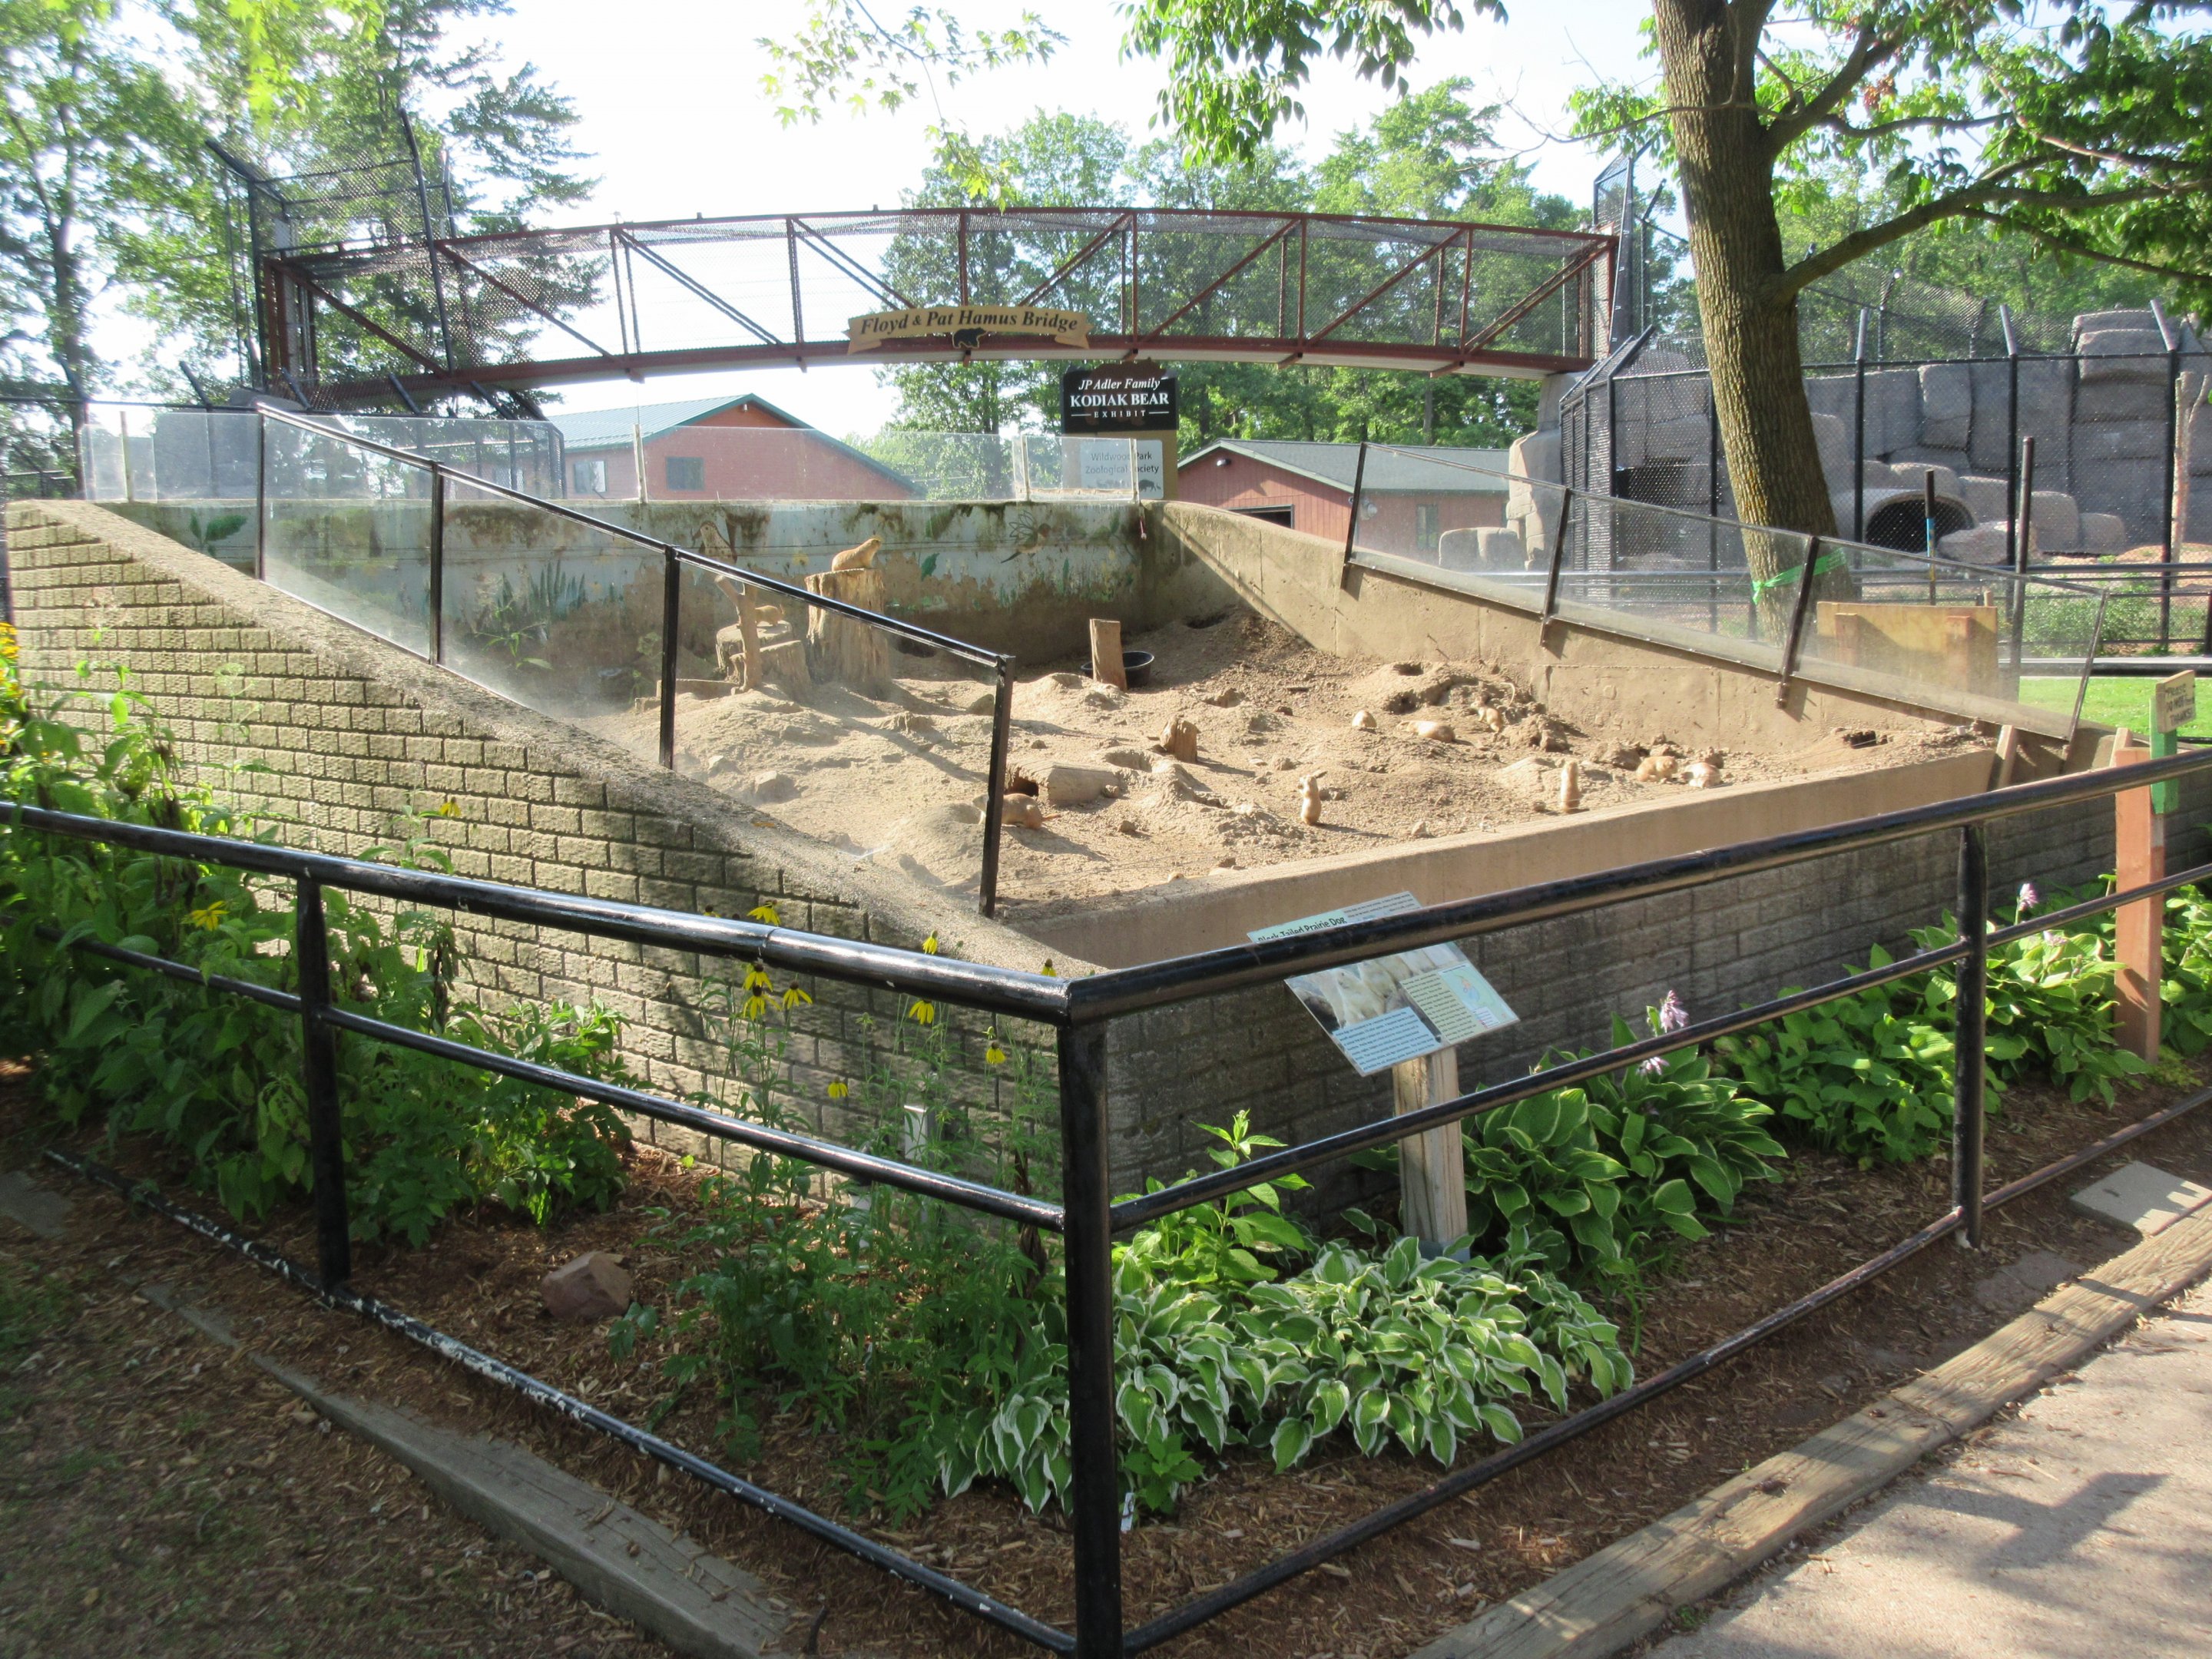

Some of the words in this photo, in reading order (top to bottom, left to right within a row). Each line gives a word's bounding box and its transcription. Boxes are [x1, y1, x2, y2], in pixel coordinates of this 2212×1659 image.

[860, 314, 909, 335] Floyd
[912, 316, 922, 326] &
[926, 311, 954, 327] Pat
[959, 310, 1017, 326] Hamus
[1022, 311, 1078, 333] Bridge
[1078, 379, 1093, 390] JP
[1093, 379, 1121, 390] Adler
[1124, 378, 1161, 390] Family
[1070, 393, 1128, 408] KODIAK
[1131, 392, 1169, 406] BEAR
[1094, 409, 1147, 419] EXHIBIT
[1085, 464, 1128, 475] Zoological
[1137, 464, 1159, 474] ociety
[1304, 920, 1330, 932] Prairie
